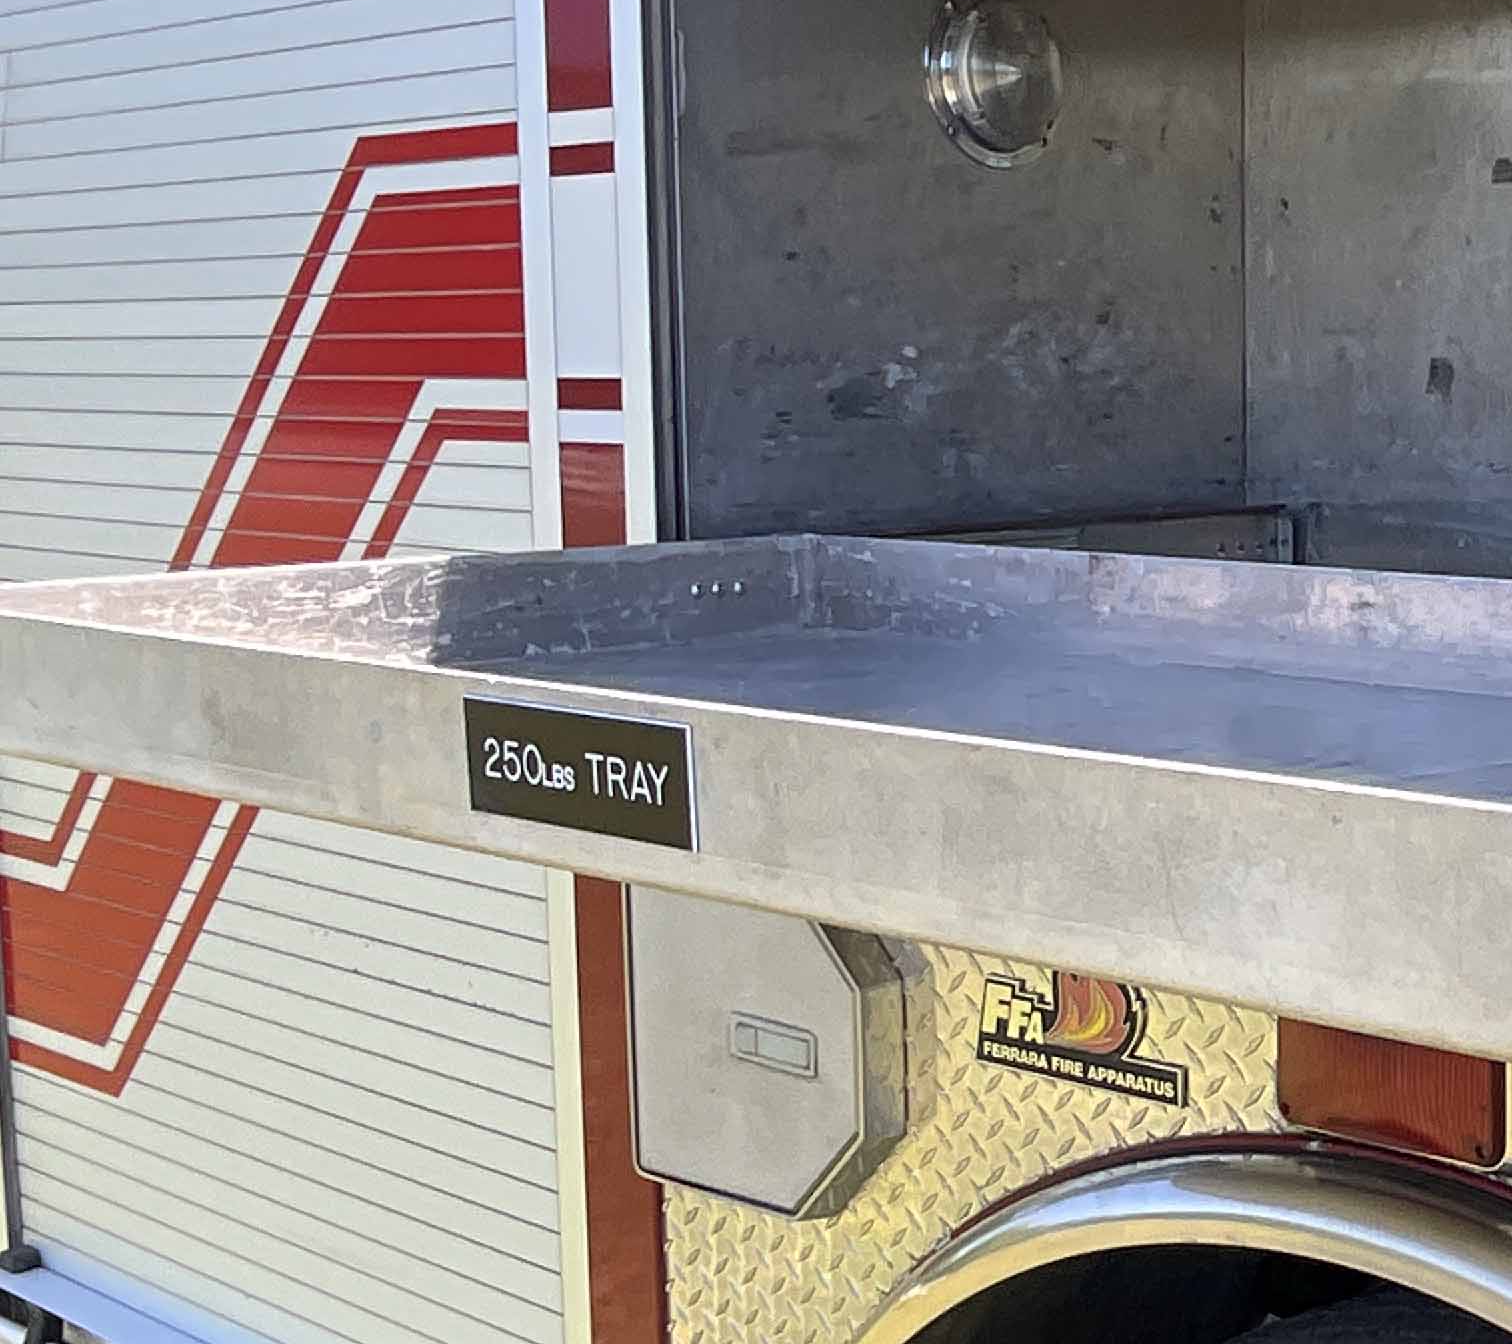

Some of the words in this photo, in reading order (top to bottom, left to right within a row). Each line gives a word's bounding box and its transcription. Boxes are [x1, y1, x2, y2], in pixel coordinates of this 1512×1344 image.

[585, 752, 669, 806] TRAY
[982, 982, 1045, 1043] FFA
[983, 1041, 1048, 1070] FERRARA
[1051, 1057, 1085, 1078] FIRE
[1087, 1064, 1175, 1099] APPARATUS
